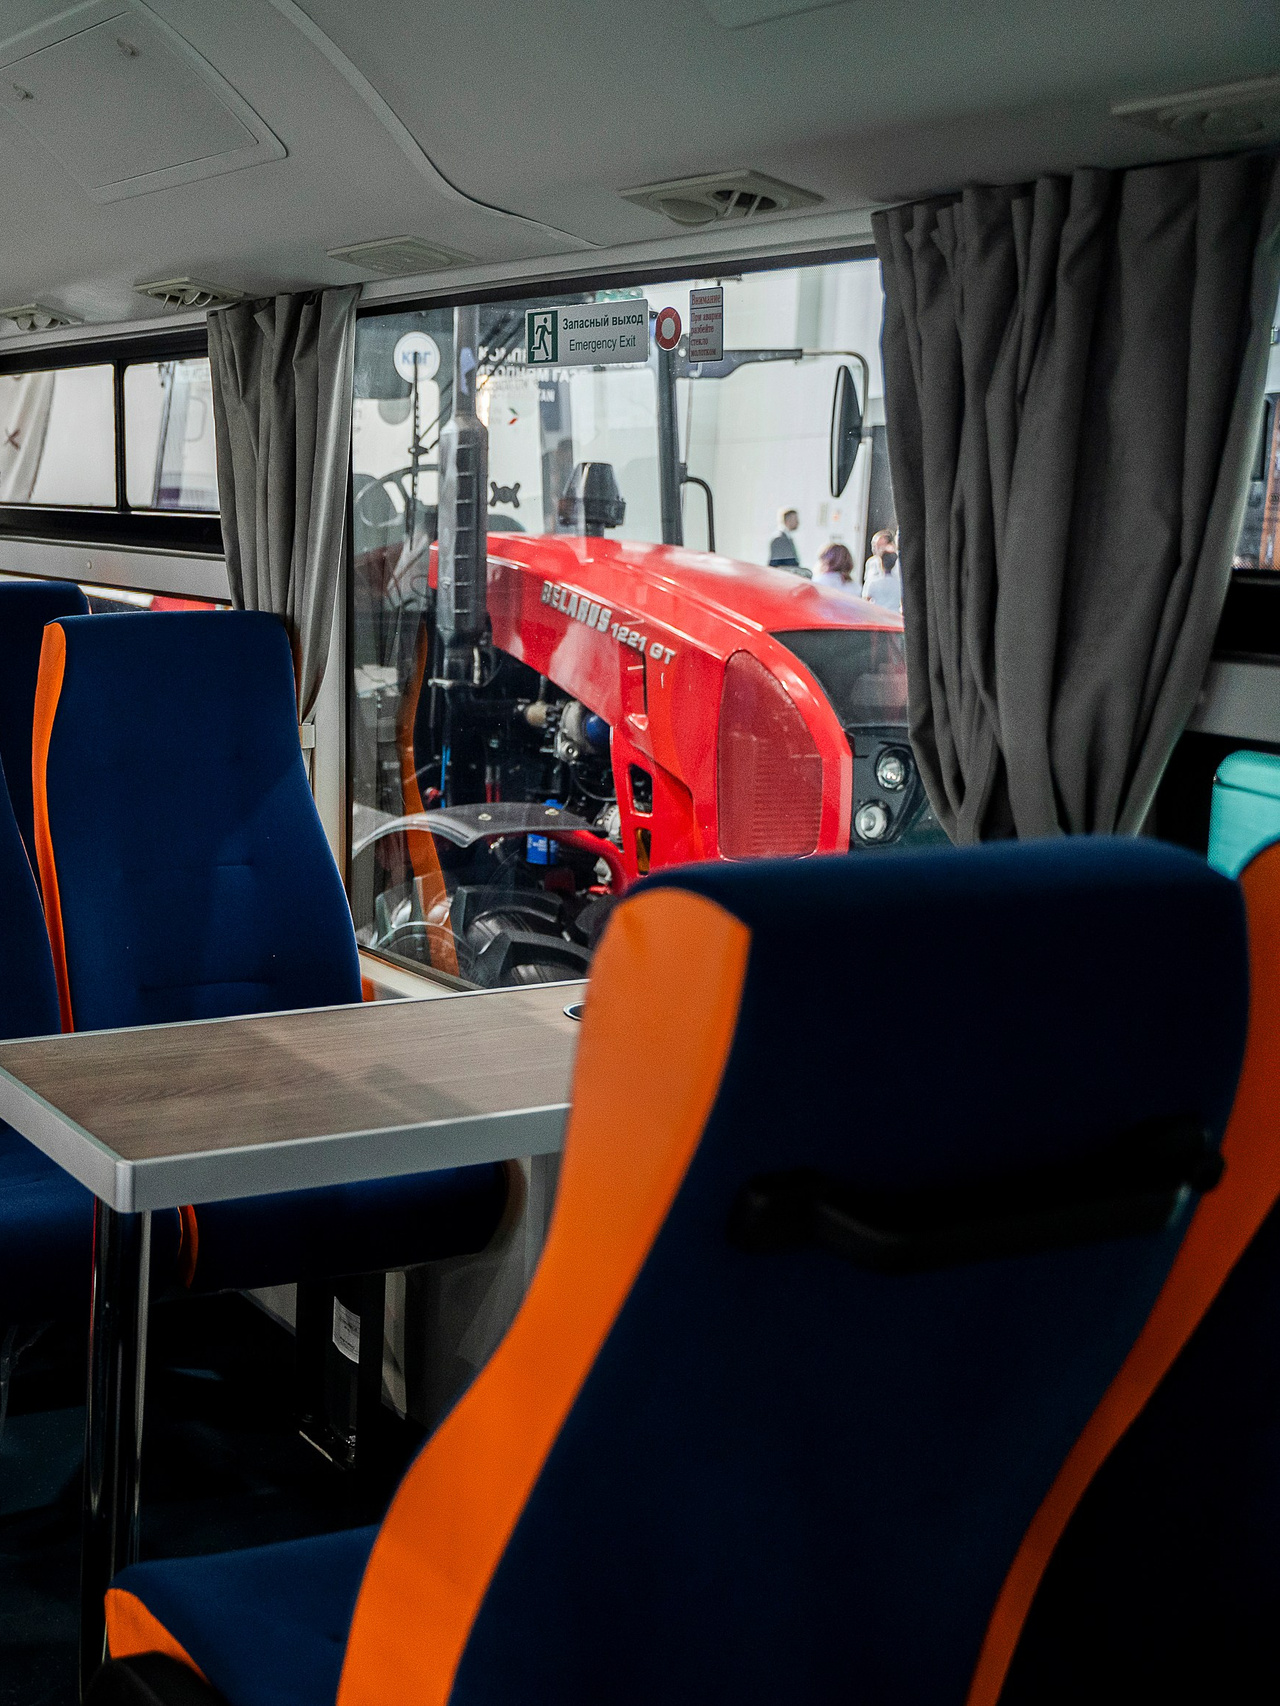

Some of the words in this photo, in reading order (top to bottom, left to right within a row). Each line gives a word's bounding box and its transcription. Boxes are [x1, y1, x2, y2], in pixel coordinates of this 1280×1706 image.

[692, 294, 721, 305] Внимание
[562, 315, 609, 330] Запасный
[612, 314, 644, 326] выход
[691, 313, 702, 324] При
[691, 324, 715, 336] разбейте
[569, 339, 617, 353] Emergency
[620, 335, 636, 348] Exit
[691, 338, 709, 346] стекло
[691, 348, 717, 357] молотком
[541, 580, 612, 633] BELARUS
[610, 622, 648, 652] 1221
[649, 642, 677, 665] GT
